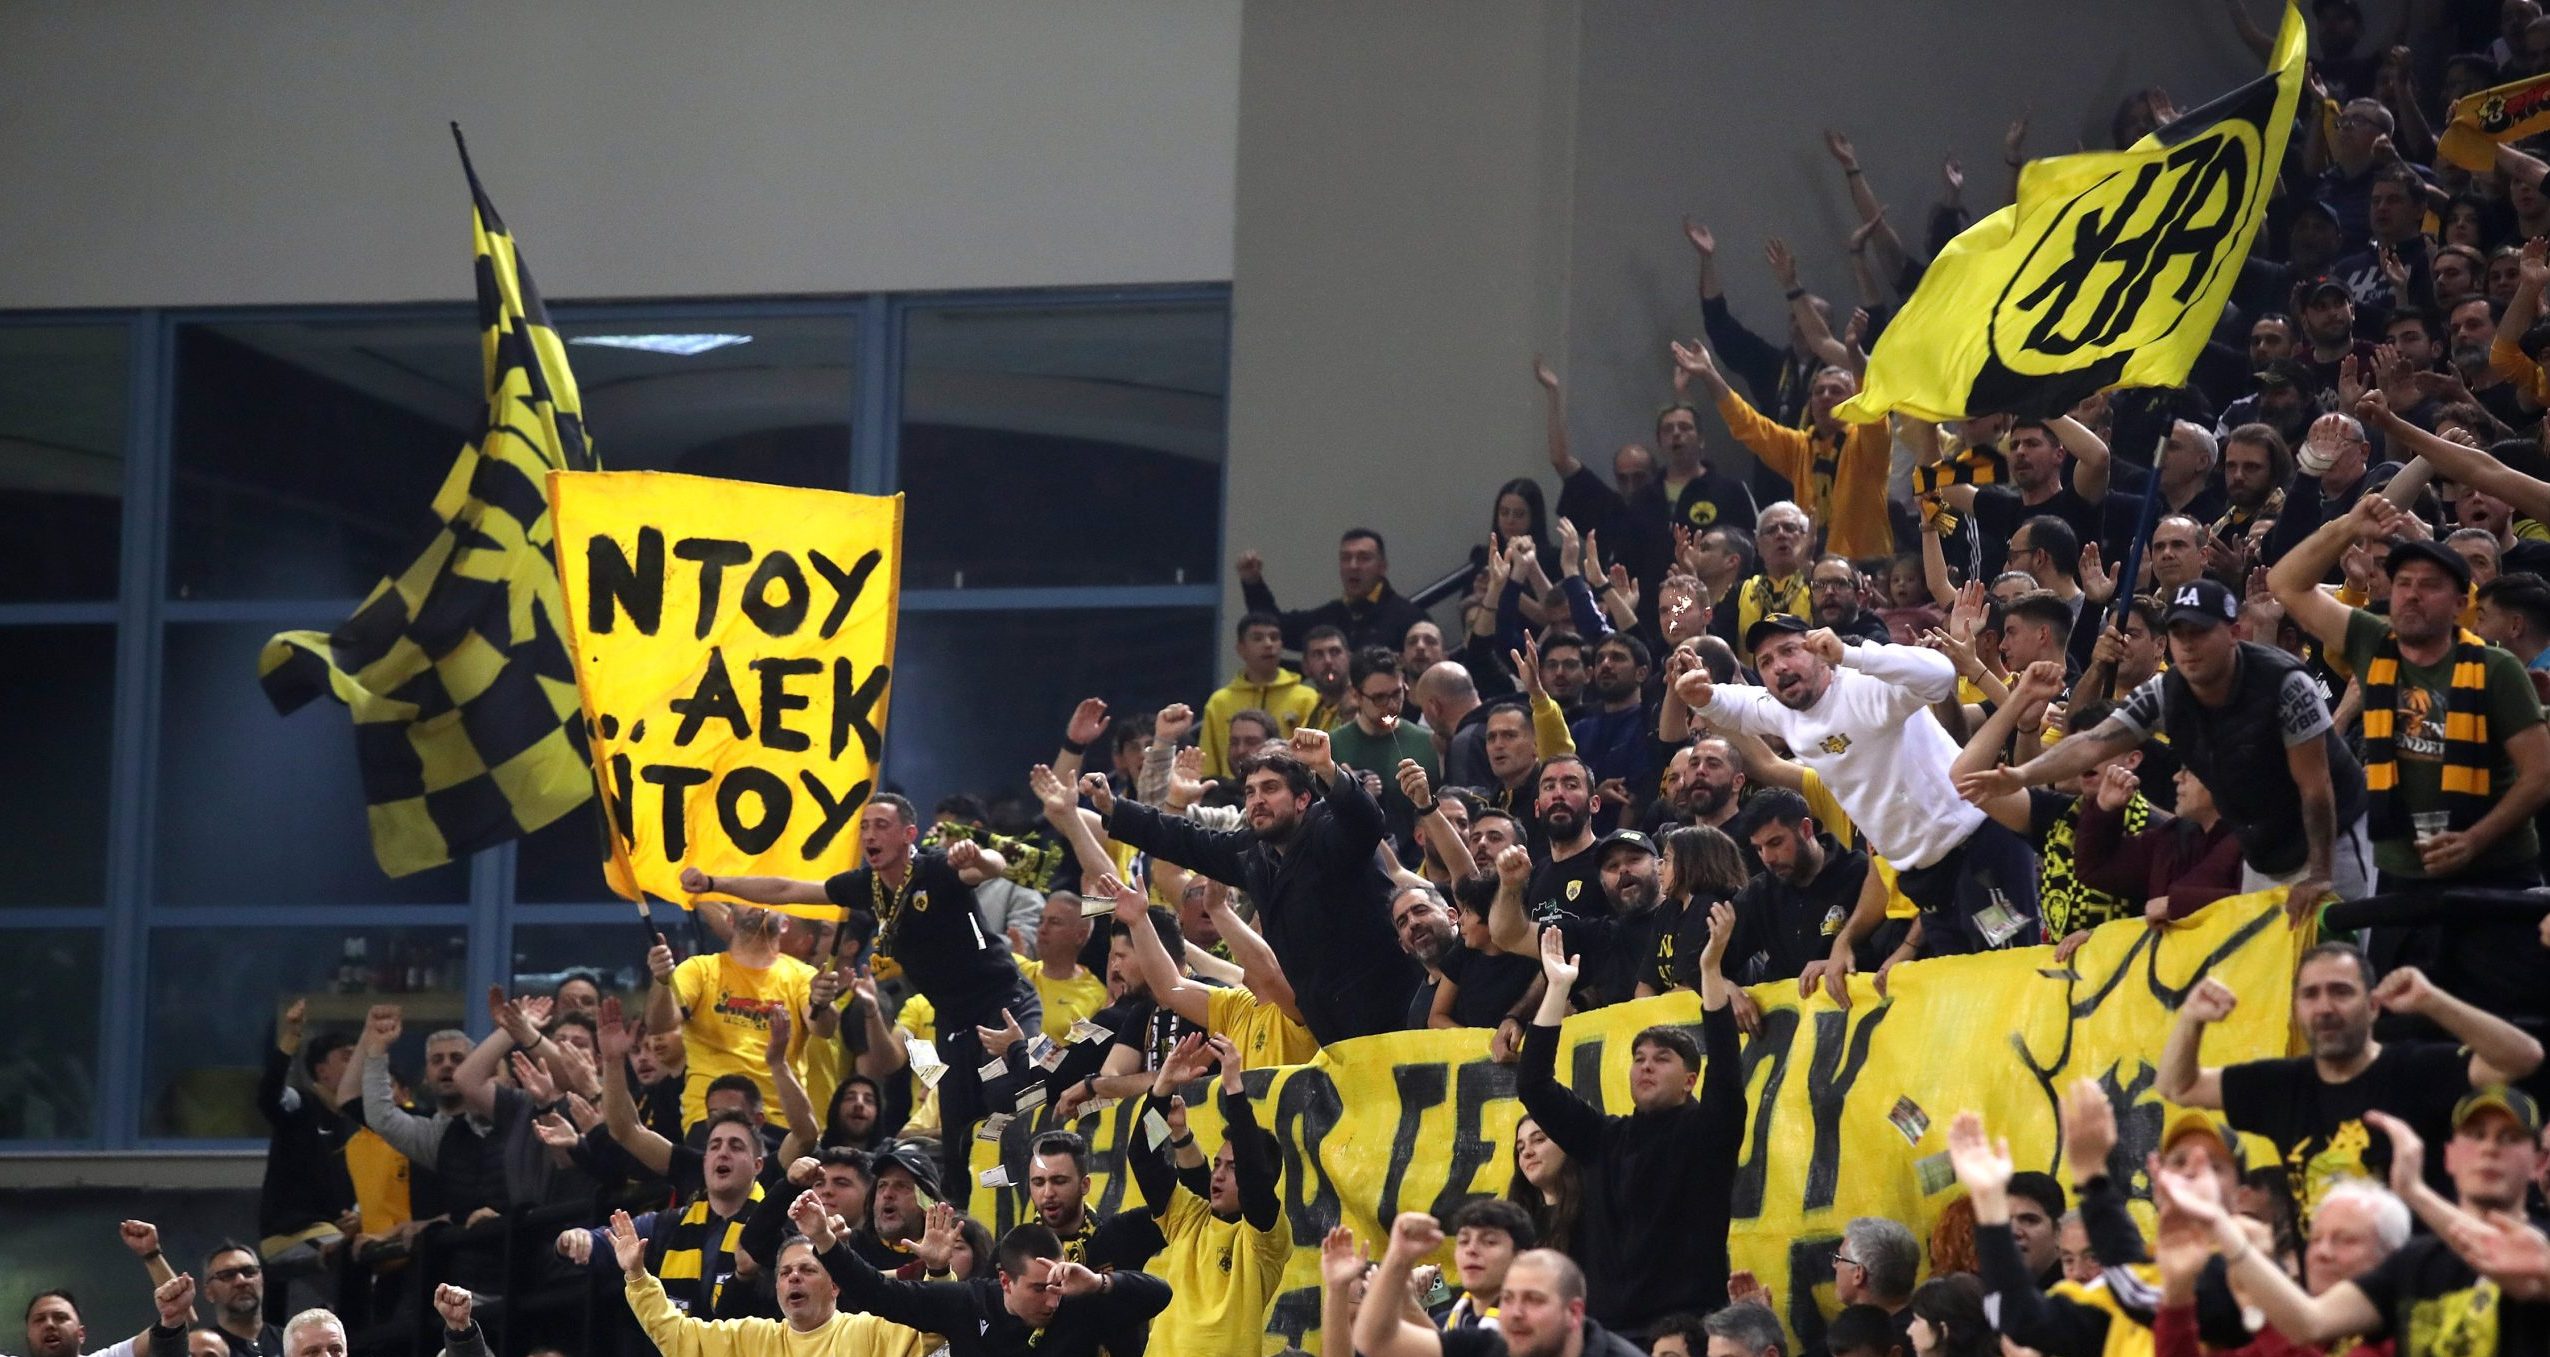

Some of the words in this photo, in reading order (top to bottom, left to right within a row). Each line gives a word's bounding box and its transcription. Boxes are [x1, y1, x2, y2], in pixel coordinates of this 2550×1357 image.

[587, 525, 884, 640] ΝΤΟΥ
[2173, 586, 2200, 606] LA
[670, 646, 891, 763] ΑΕΚ
